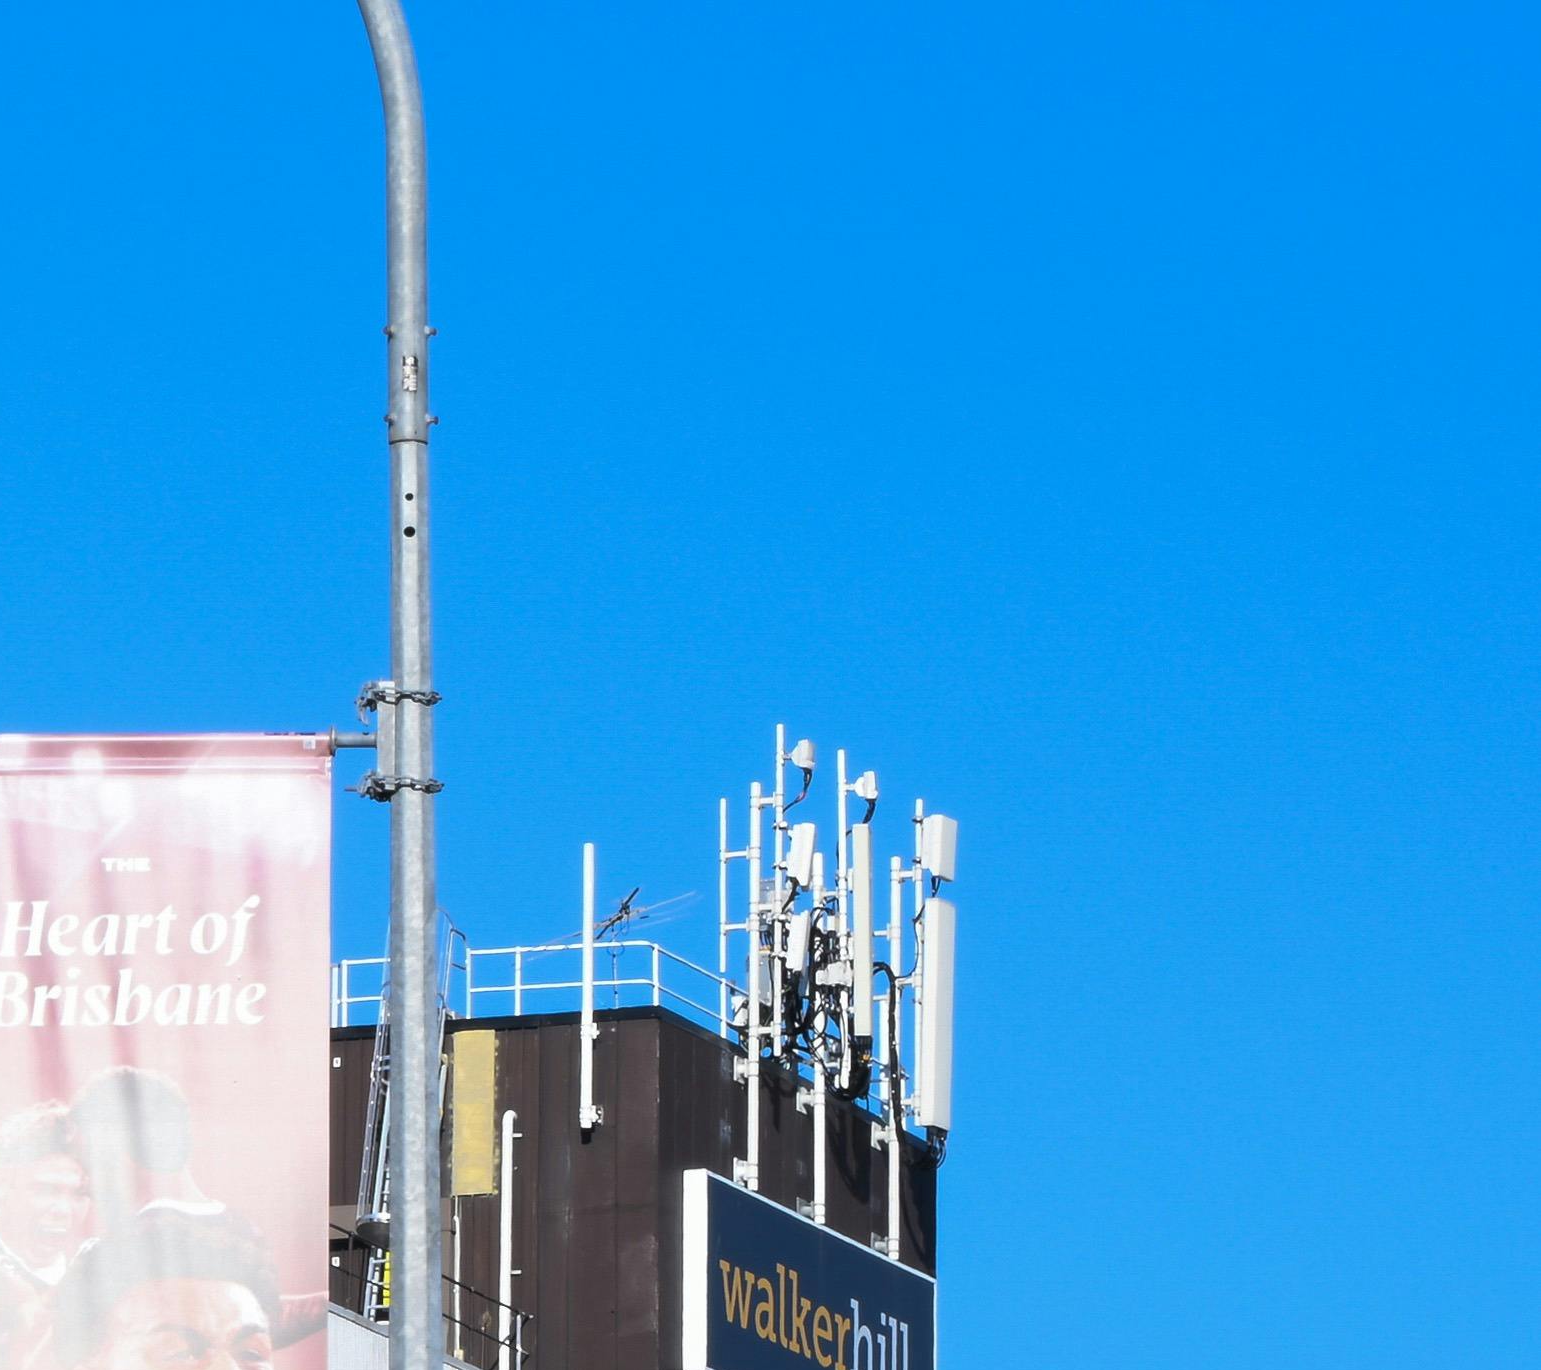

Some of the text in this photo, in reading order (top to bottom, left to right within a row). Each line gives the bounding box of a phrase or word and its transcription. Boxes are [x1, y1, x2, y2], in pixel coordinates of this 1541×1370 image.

[102, 858, 150, 872] THE
[0, 894, 260, 966] Heart of
